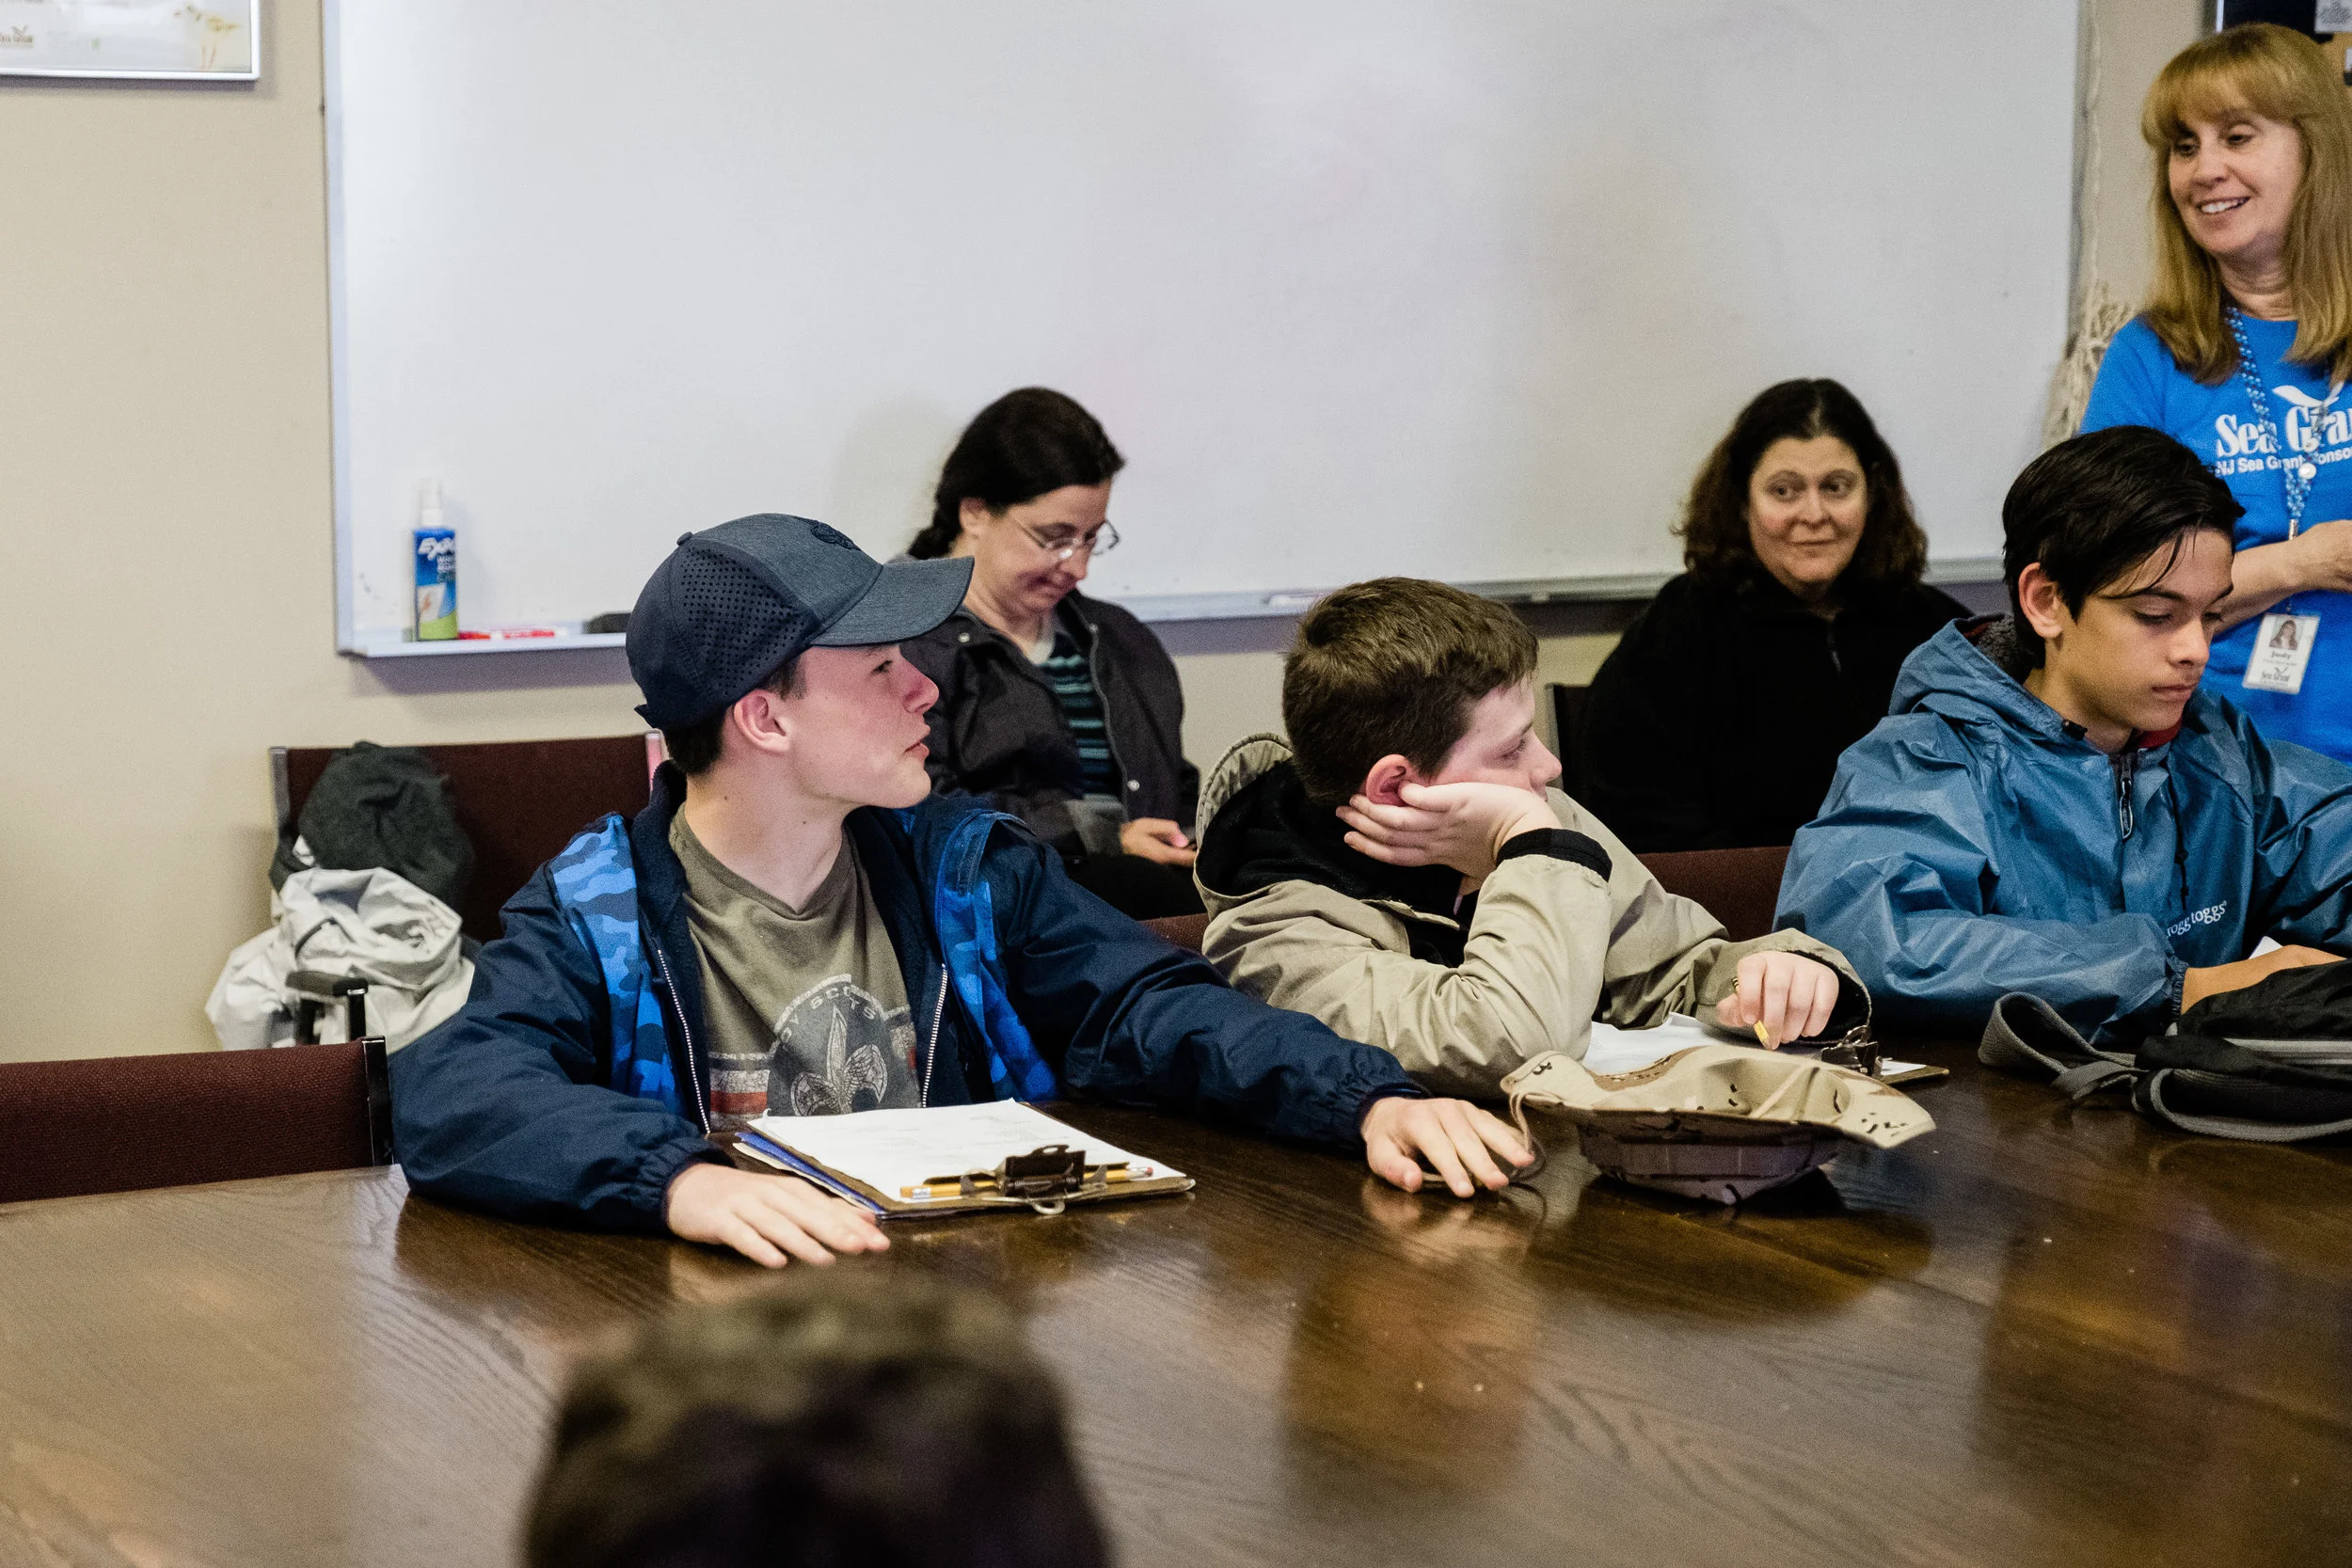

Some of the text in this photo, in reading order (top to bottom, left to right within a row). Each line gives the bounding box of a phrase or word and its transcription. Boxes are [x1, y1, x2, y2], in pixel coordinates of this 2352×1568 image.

[2215, 405, 2352, 458] Sea Gra
[2216, 460, 2235, 476] NJ
[2237, 457, 2265, 473] Sea
[2166, 903, 2226, 939] rogg toggs
